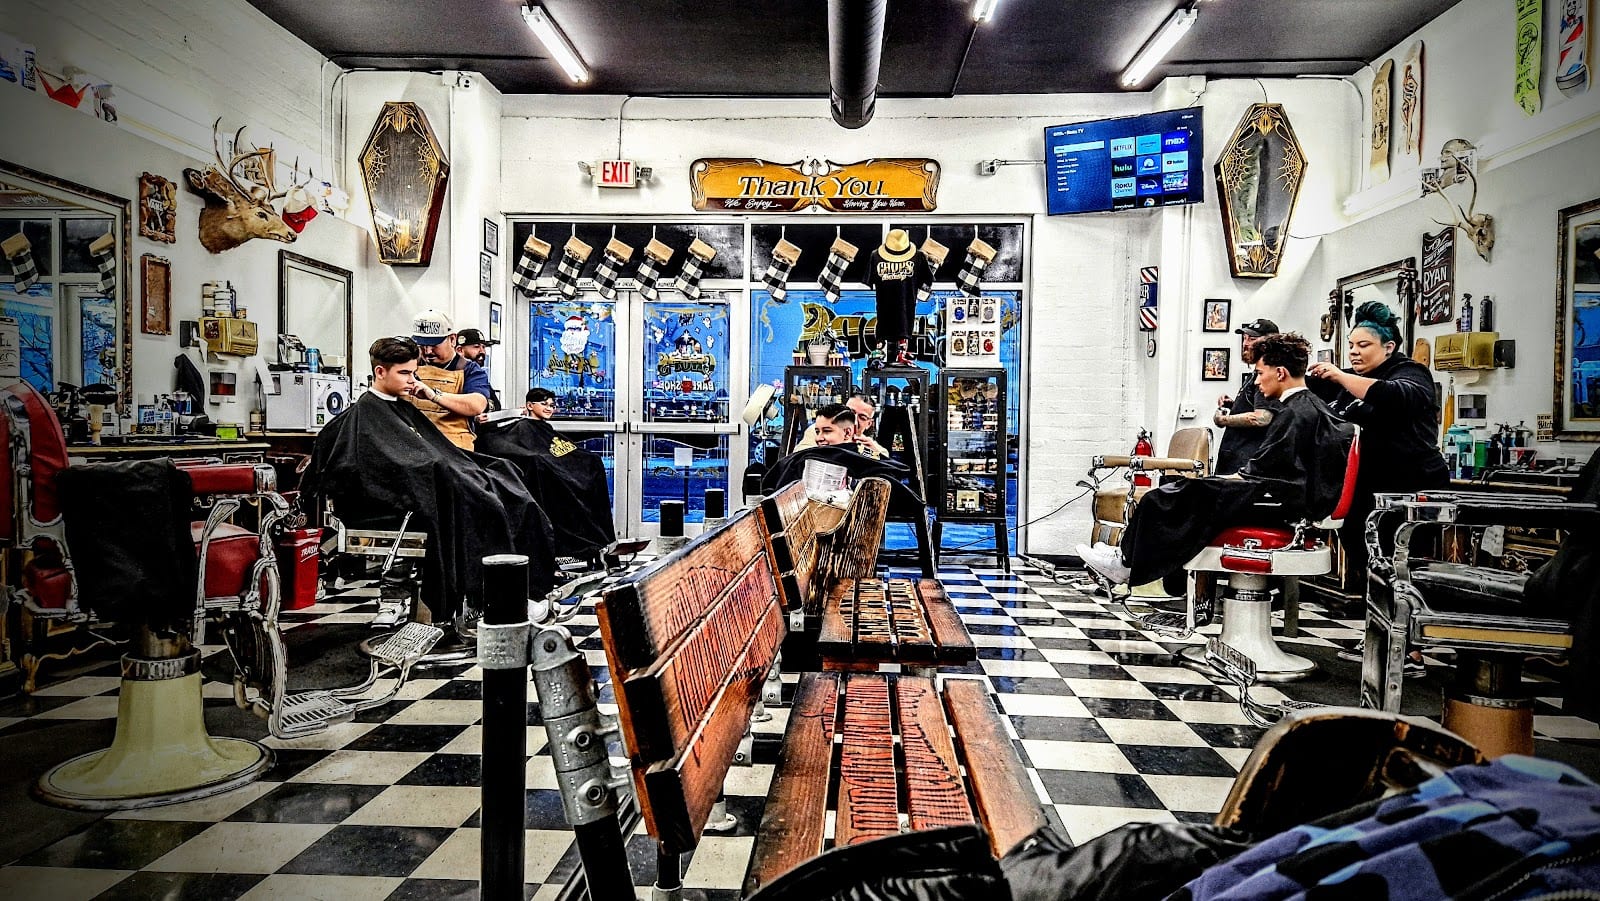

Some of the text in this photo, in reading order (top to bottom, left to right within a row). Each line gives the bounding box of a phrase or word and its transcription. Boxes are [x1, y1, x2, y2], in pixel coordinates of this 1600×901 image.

[1165, 137, 1185, 146] max
[1113, 143, 1133, 152] NETFLIX
[602, 161, 631, 183] EXIT
[1113, 163, 1133, 172] hulu
[738, 176, 827, 198] Thank
[725, 198, 742, 208] We
[842, 199, 869, 211] Having
[872, 198, 888, 211] You
[1423, 266, 1447, 292] RYAN
[1537, 420, 1554, 430] Bitch
[300, 544, 319, 557] TRASH
